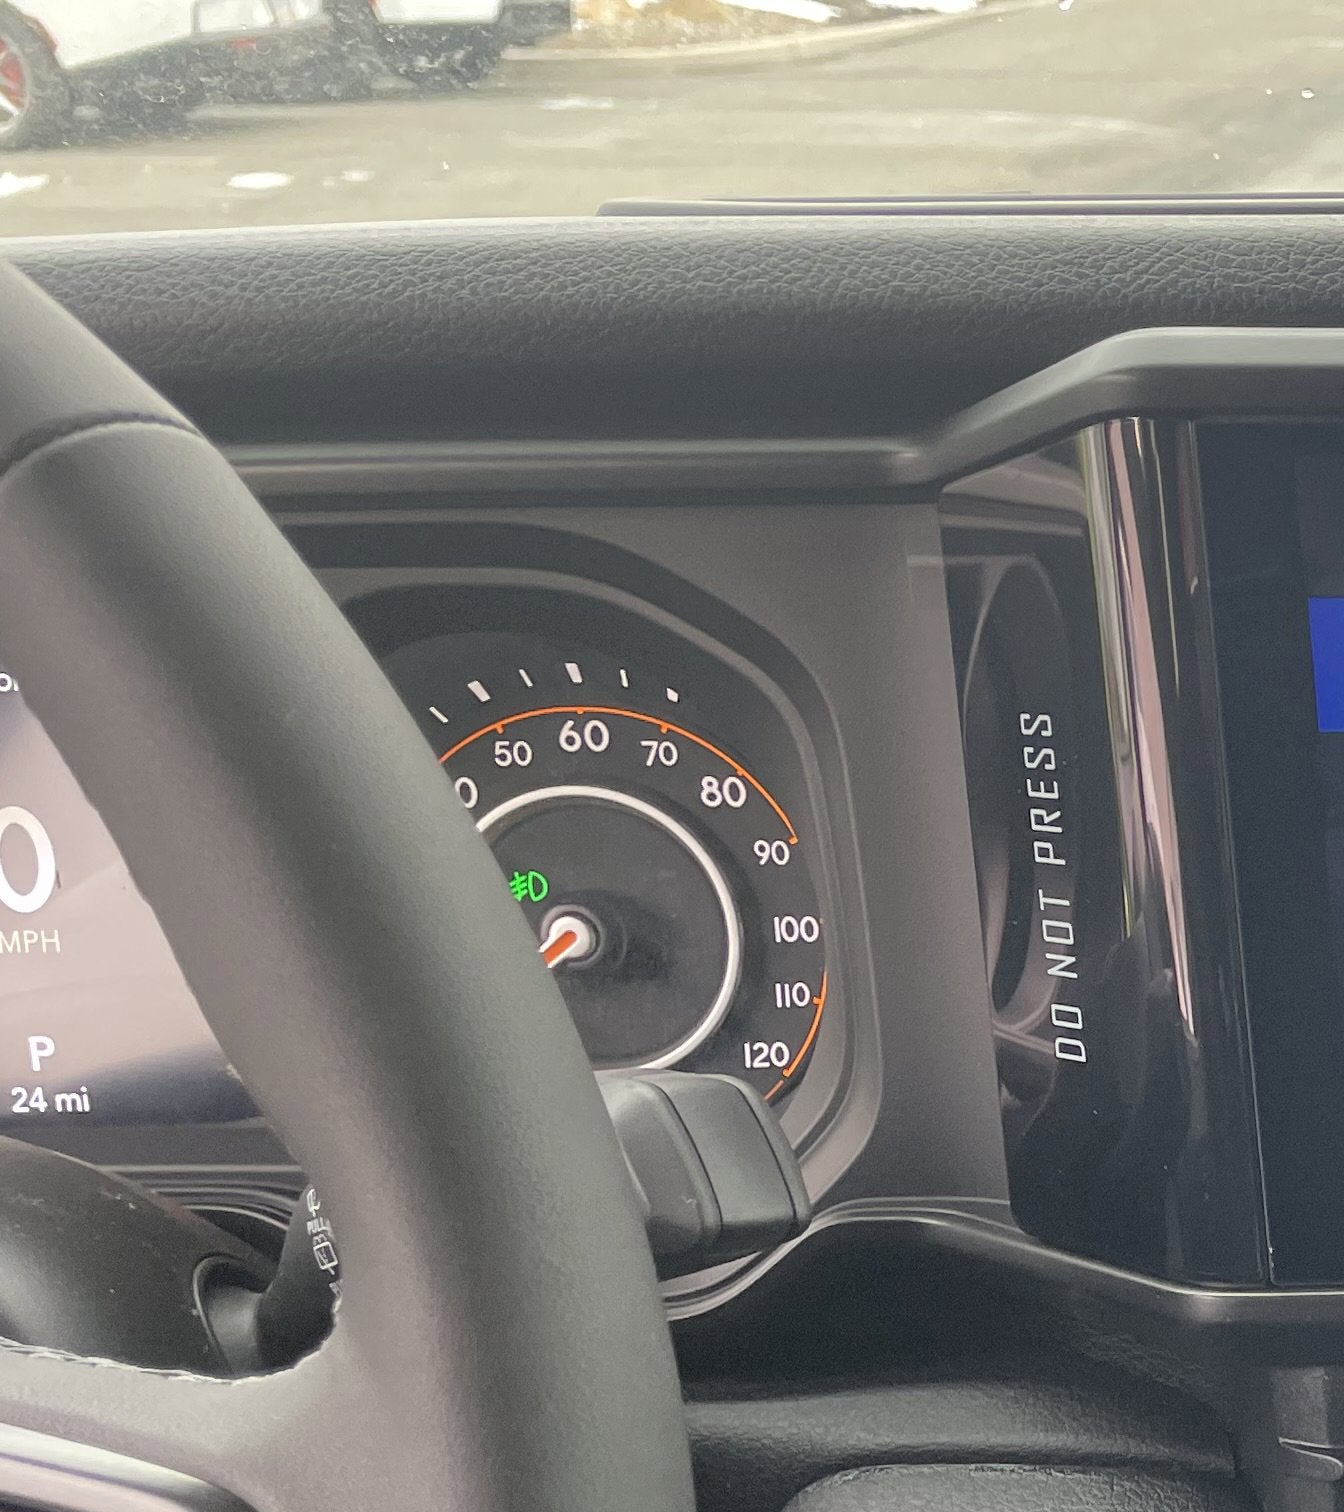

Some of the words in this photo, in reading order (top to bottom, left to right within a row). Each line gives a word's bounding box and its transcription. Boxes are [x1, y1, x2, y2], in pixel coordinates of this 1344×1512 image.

[558, 719, 610, 753] 60
[494, 740, 533, 767] 50
[640, 740, 678, 767] 70
[700, 774, 750, 808] 80
[1019, 711, 1068, 866] PRESS
[753, 838, 792, 866] 90
[0, 929, 60, 954] MPH
[773, 914, 823, 943] 100
[1037, 888, 1080, 980] NOT
[775, 980, 811, 1008] 110
[1051, 1004, 1089, 1064] DO
[27, 1034, 57, 1073] P
[743, 1040, 792, 1070] 120
[9, 1084, 50, 1114] 24
[54, 1084, 92, 1114] mi
